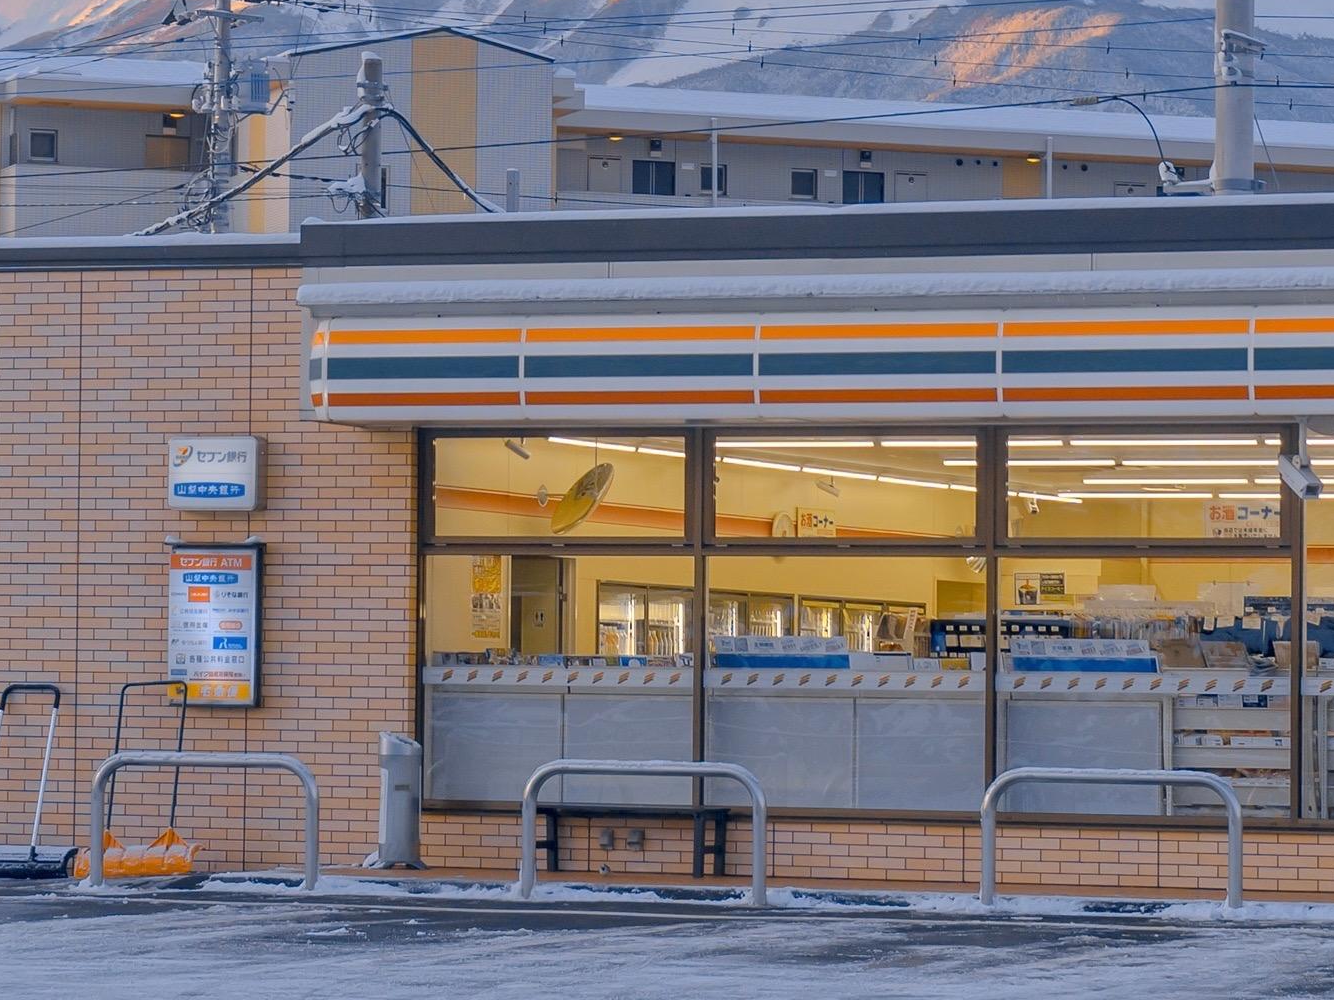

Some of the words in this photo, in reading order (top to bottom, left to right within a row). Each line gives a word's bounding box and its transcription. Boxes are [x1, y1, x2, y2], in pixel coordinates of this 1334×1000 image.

[196, 451, 247, 463] セブン銀行
[177, 485, 241, 495] 山梨中央銀行
[180, 557, 217, 567] セブン銀行
[220, 557, 243, 567] ATM
